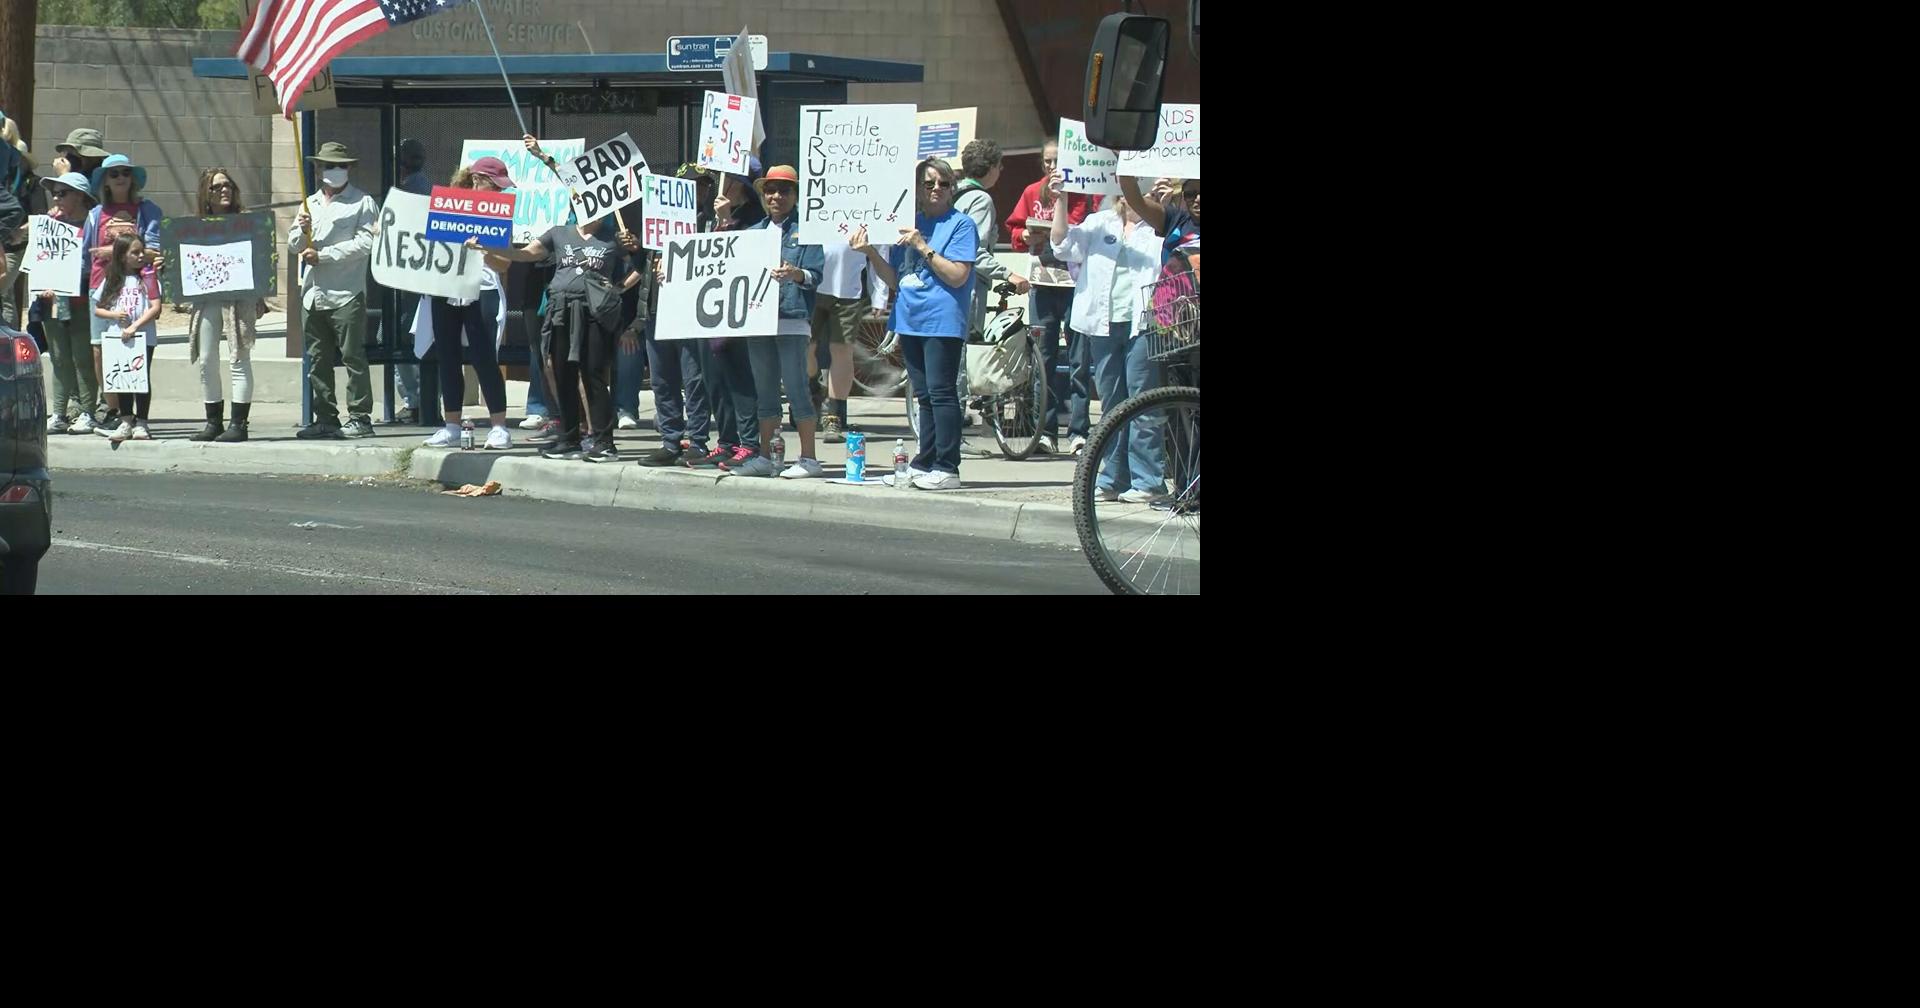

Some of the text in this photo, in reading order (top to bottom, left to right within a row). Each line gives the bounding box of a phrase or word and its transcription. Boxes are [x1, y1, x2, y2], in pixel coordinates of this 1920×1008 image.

[507, 23, 574, 42] SERVICE
[806, 109, 879, 136] Terrible
[705, 93, 752, 173] RESIST
[1164, 130, 1193, 143] our
[808, 136, 899, 163] Revolting
[1123, 144, 1200, 161] Democrac
[575, 140, 632, 186] BAD
[808, 159, 867, 176] Unfit
[807, 178, 868, 197] Moron
[433, 197, 511, 216] SAVE OUR
[37, 218, 74, 238] HANDS
[431, 220, 507, 237] DEMOCRACY
[37, 236, 79, 252] HANDS
[375, 207, 469, 276] RESIST
